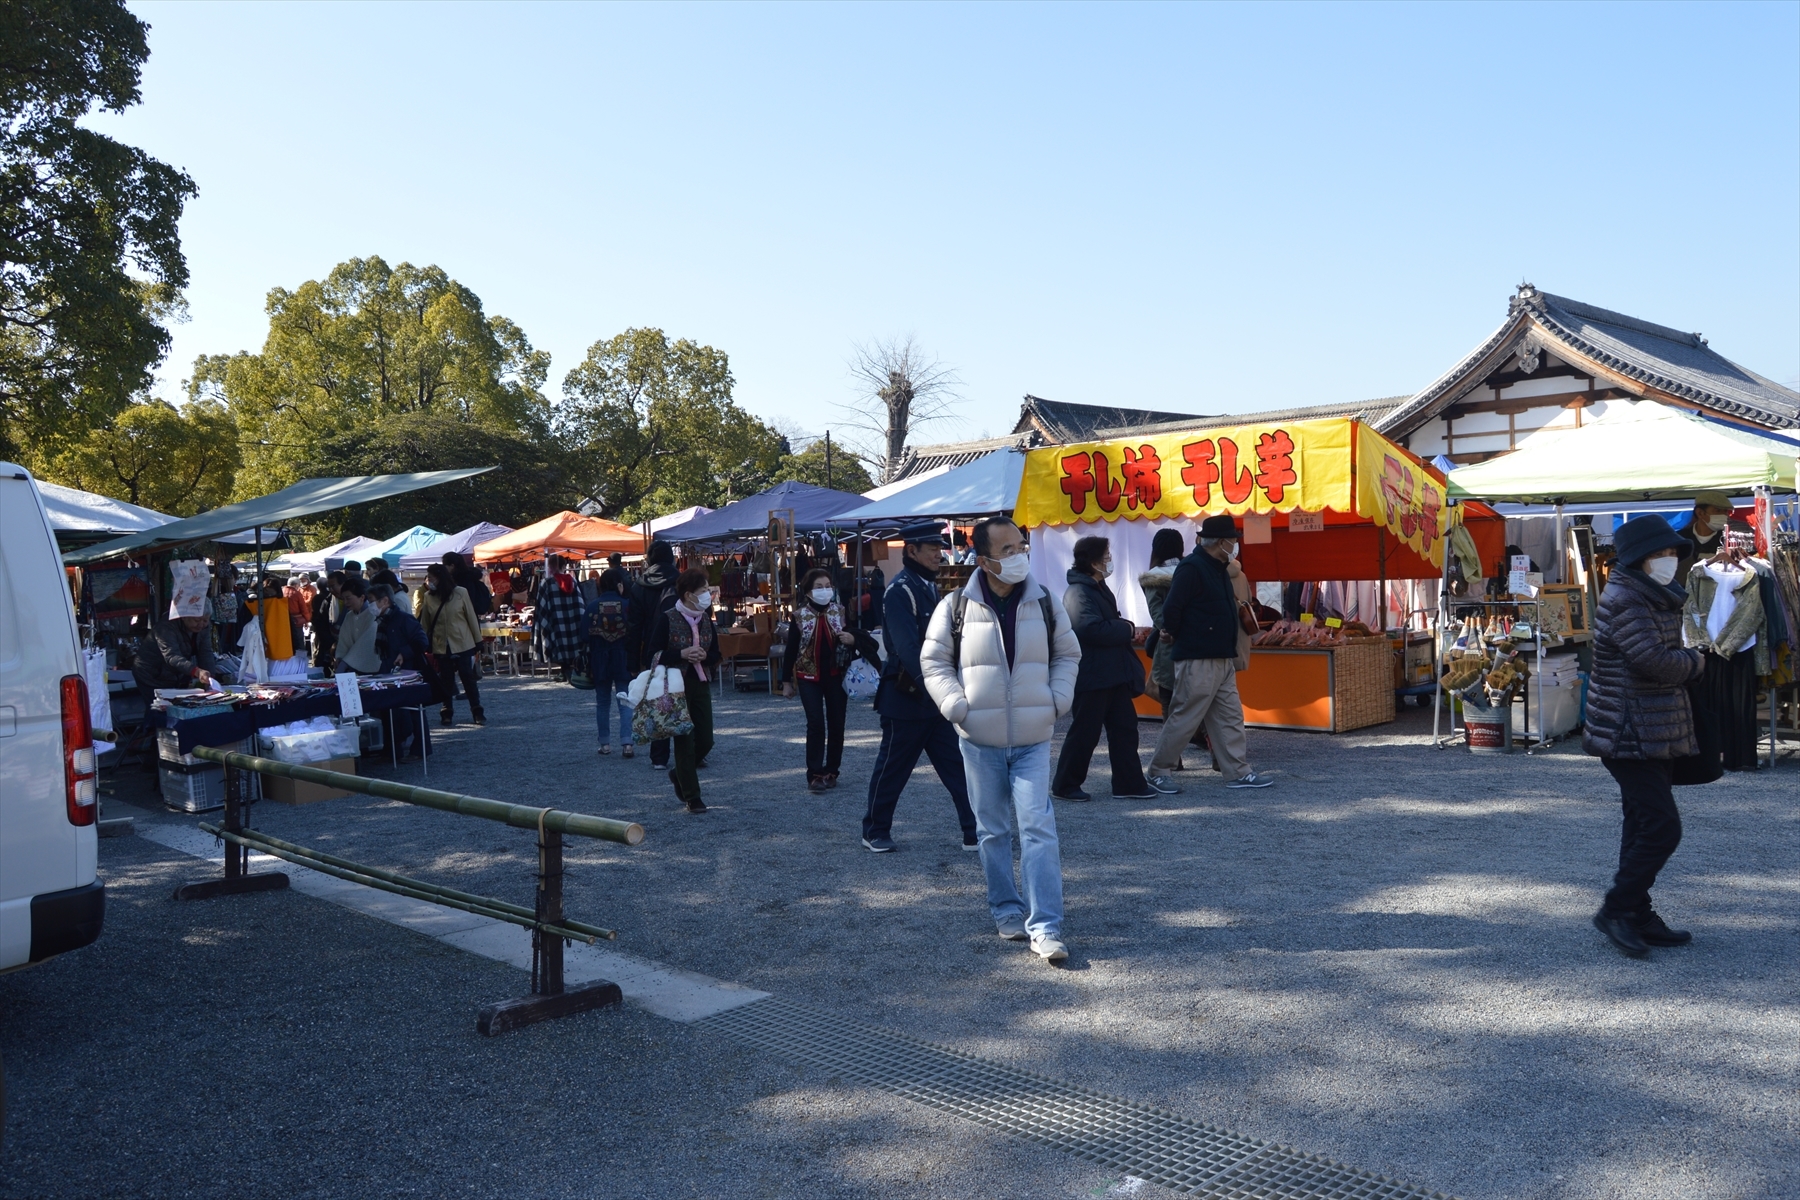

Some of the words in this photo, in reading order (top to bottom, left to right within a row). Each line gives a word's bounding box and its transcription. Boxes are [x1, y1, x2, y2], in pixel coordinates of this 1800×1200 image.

[1060, 444, 1161, 514] 干し柿
[1180, 429, 1297, 507] 干し芋
[1380, 453, 1441, 552] 干し芋
